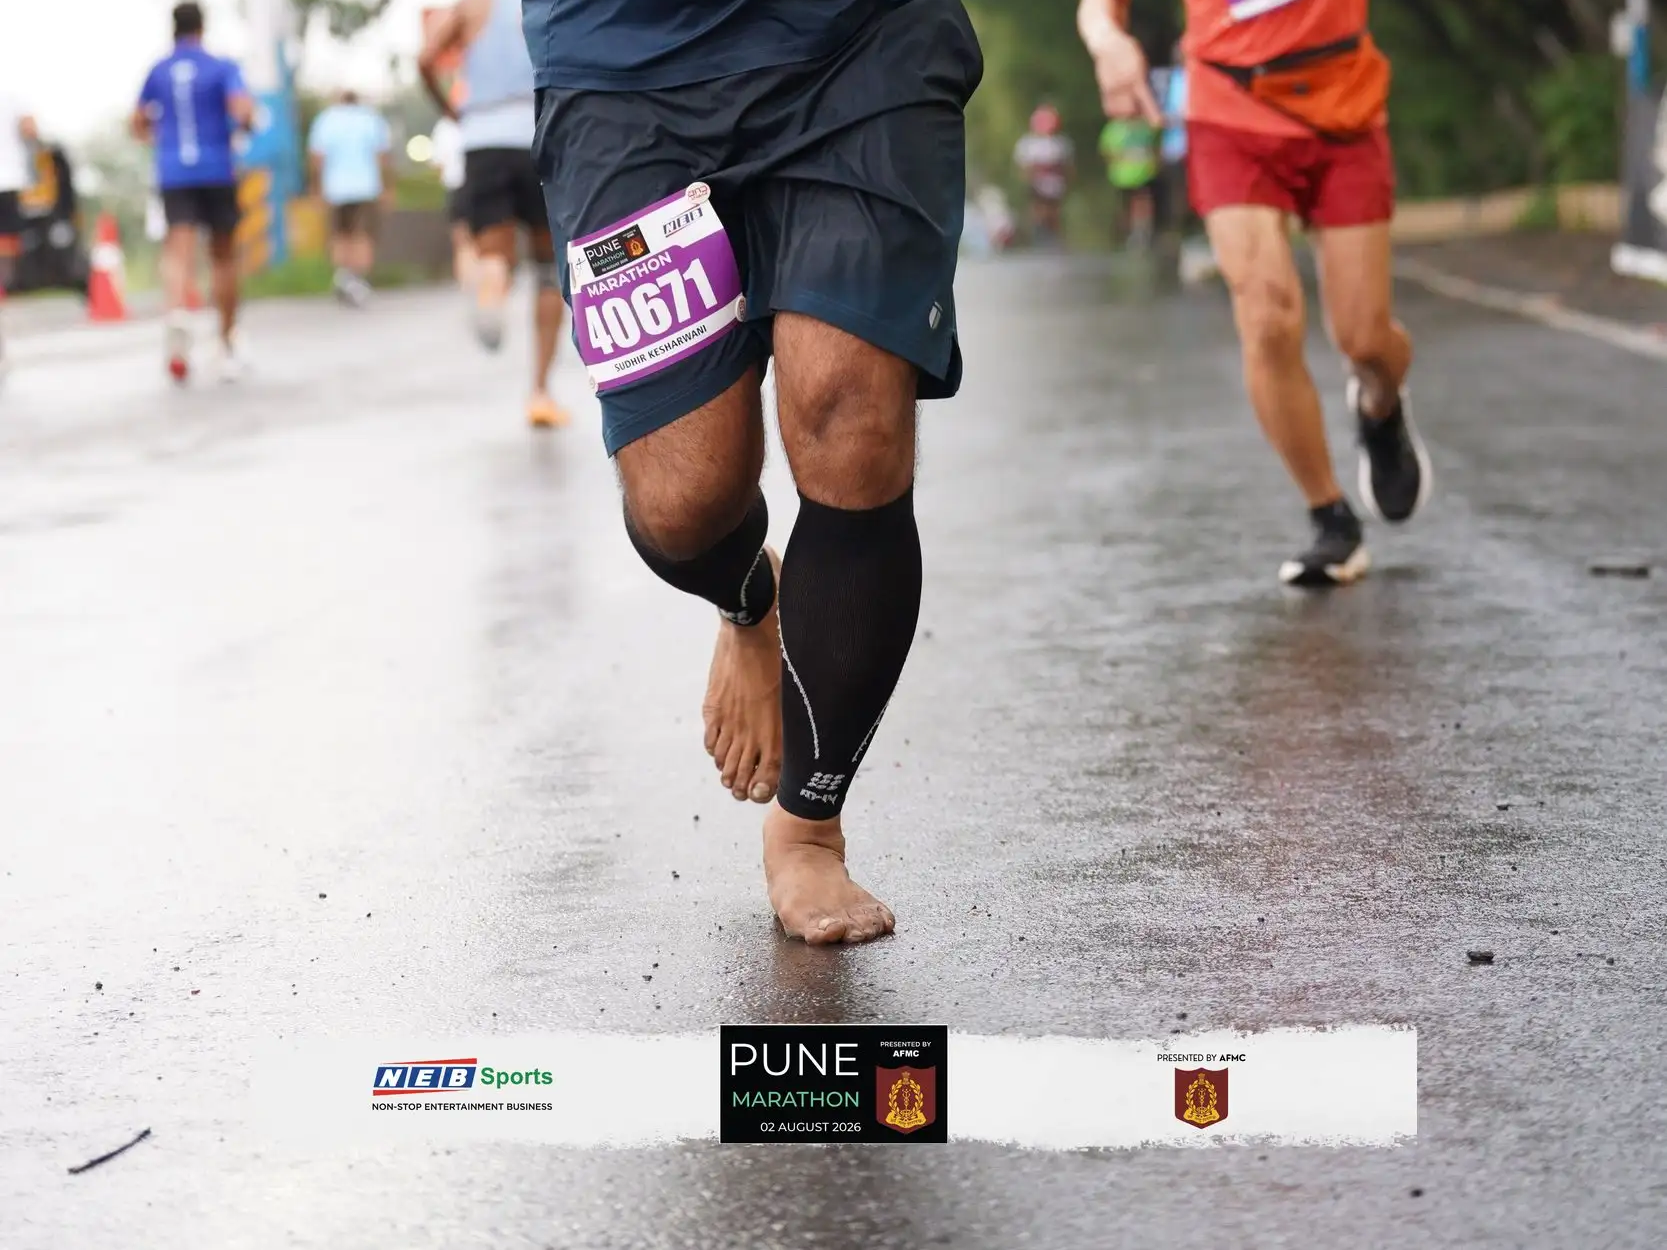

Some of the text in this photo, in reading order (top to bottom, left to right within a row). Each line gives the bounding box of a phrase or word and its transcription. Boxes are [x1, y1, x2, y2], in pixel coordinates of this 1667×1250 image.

[586, 239, 621, 260] PUNE
[592, 250, 625, 269] MARATHON
[587, 252, 672, 298] MARATHON
[585, 258, 717, 355] 40671
[614, 325, 707, 372] SUDHIR KESHARWANI
